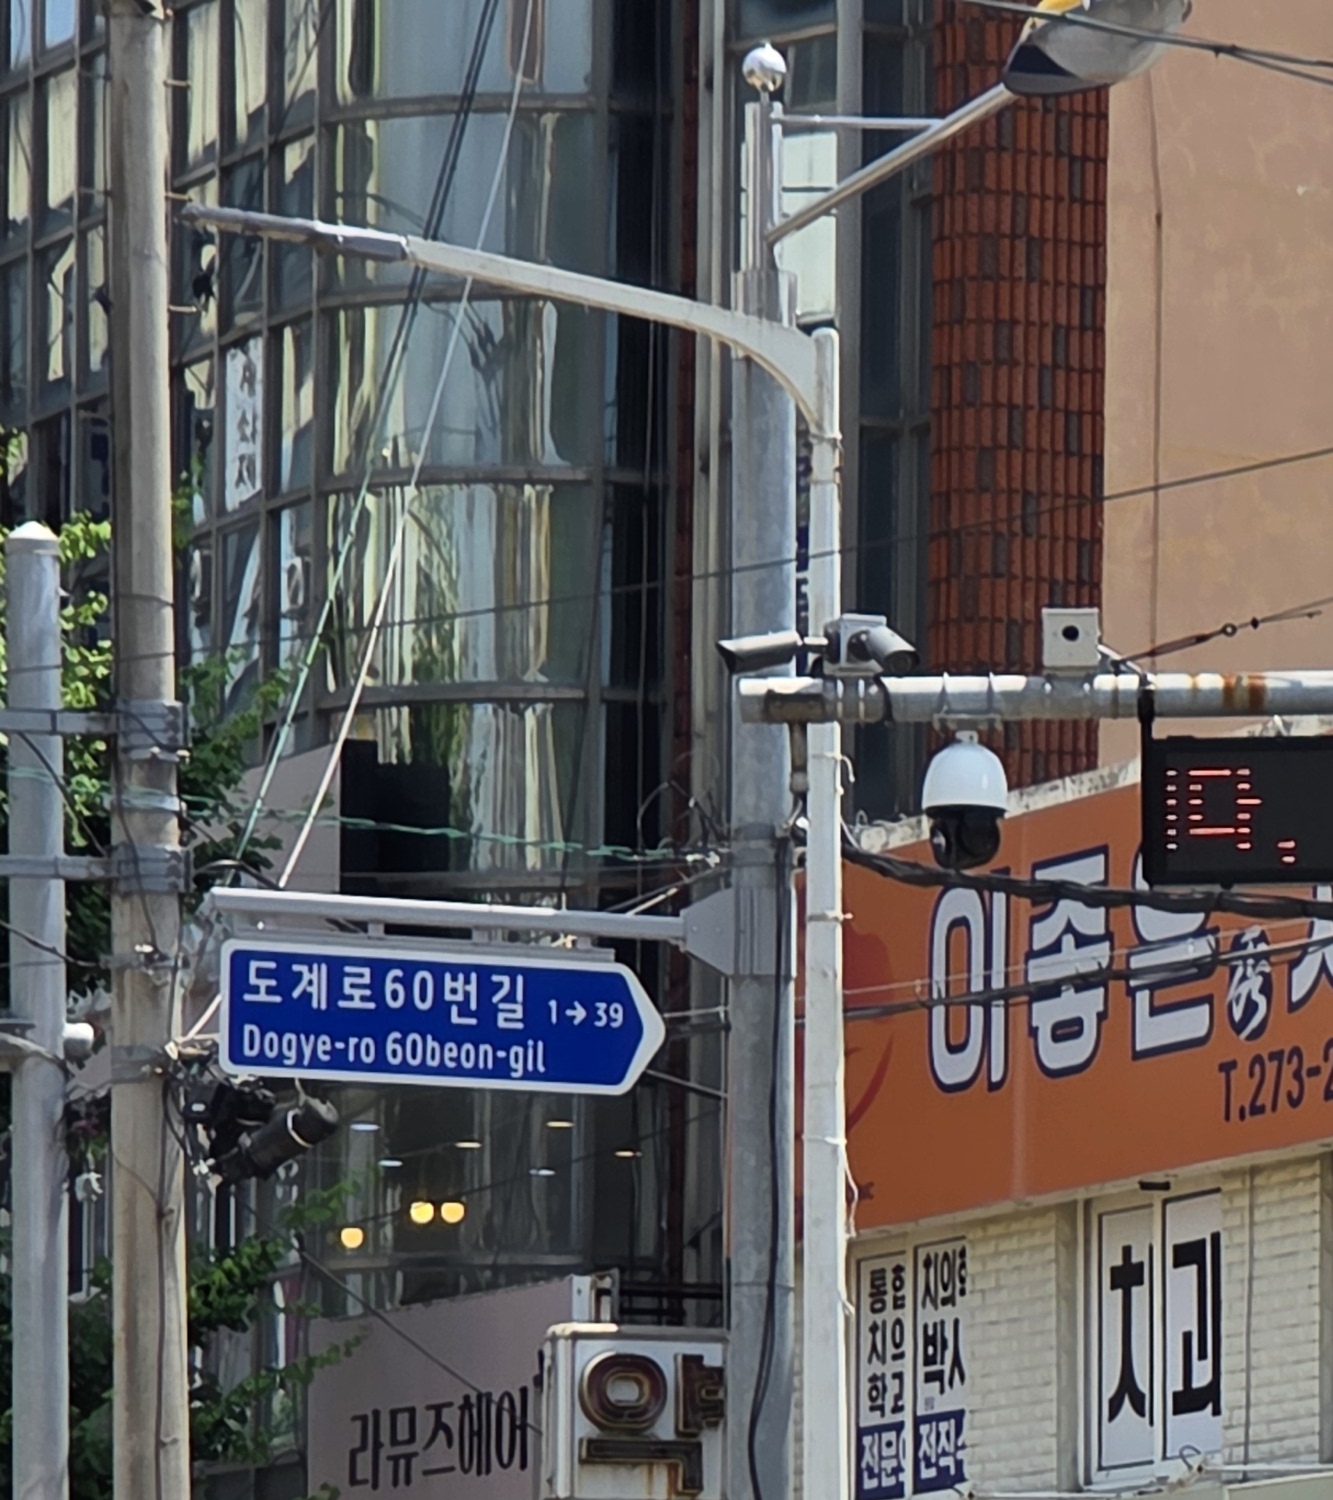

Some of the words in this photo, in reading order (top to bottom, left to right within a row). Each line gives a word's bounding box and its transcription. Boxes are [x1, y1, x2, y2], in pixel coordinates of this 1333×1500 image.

[242, 959, 527, 1030] 도계로60번길
[242, 1023, 377, 1066] Dogye-ro
[385, 1031, 547, 1079] 60beon-gil
[1108, 1230, 1221, 1426] 치과
[349, 1385, 529, 1490] 라뮤즈헤어
[579, 1352, 725, 1497] 약
